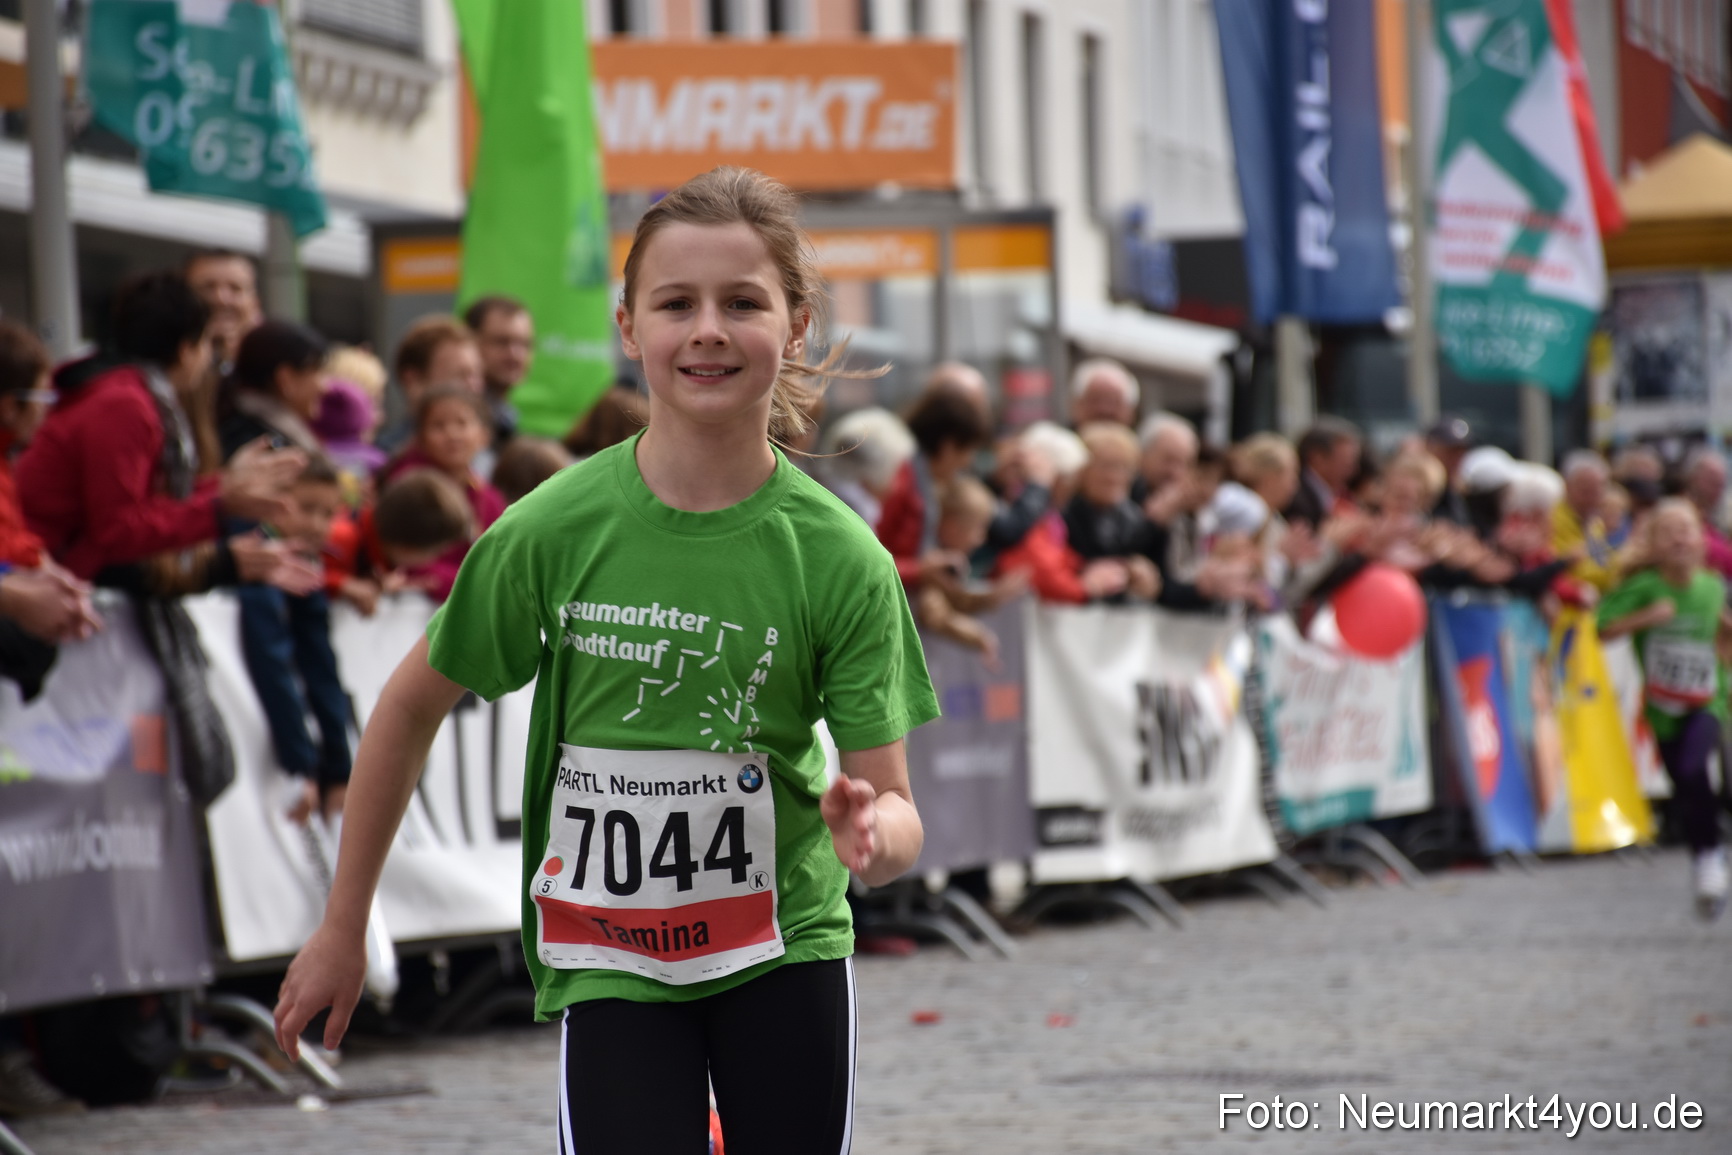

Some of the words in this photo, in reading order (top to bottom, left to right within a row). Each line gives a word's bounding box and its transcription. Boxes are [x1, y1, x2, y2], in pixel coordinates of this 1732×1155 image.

[557, 767, 604, 794] PARTL
[611, 774, 727, 796] Neumarkt
[565, 805, 752, 896] 7044
[542, 880, 552, 894] 5
[755, 874, 763, 888] K
[591, 917, 709, 953] Tamina
